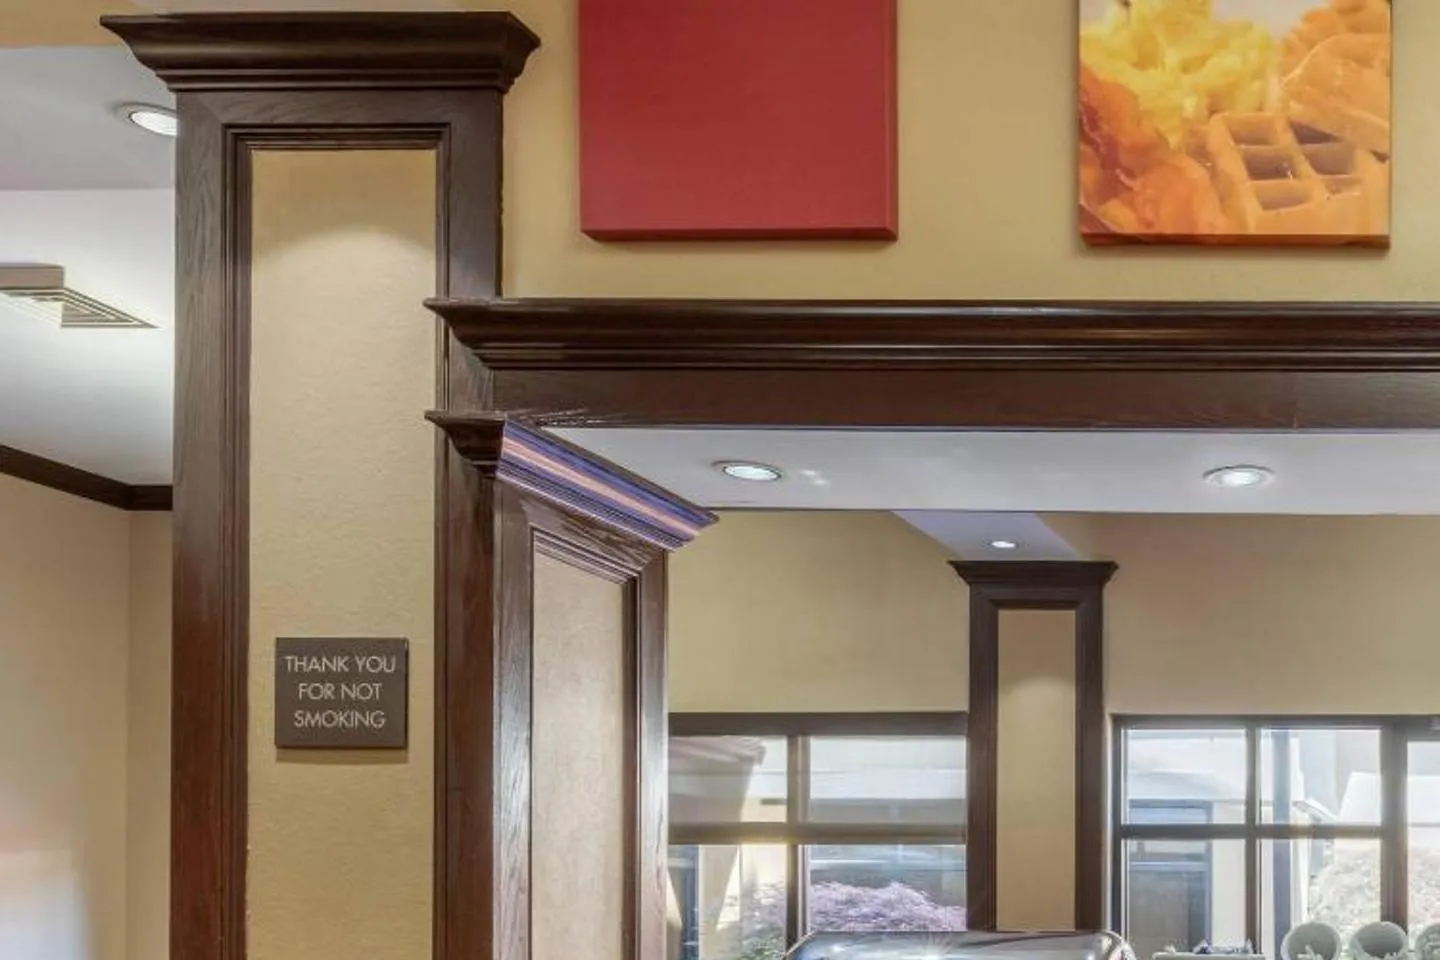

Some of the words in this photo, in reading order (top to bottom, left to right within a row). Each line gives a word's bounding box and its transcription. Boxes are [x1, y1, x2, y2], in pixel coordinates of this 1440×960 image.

[284, 655, 349, 673] THANK
[355, 655, 396, 673] YOU
[298, 682, 335, 700] FOR
[341, 682, 382, 700] NOT
[293, 709, 387, 729] SMOKING
